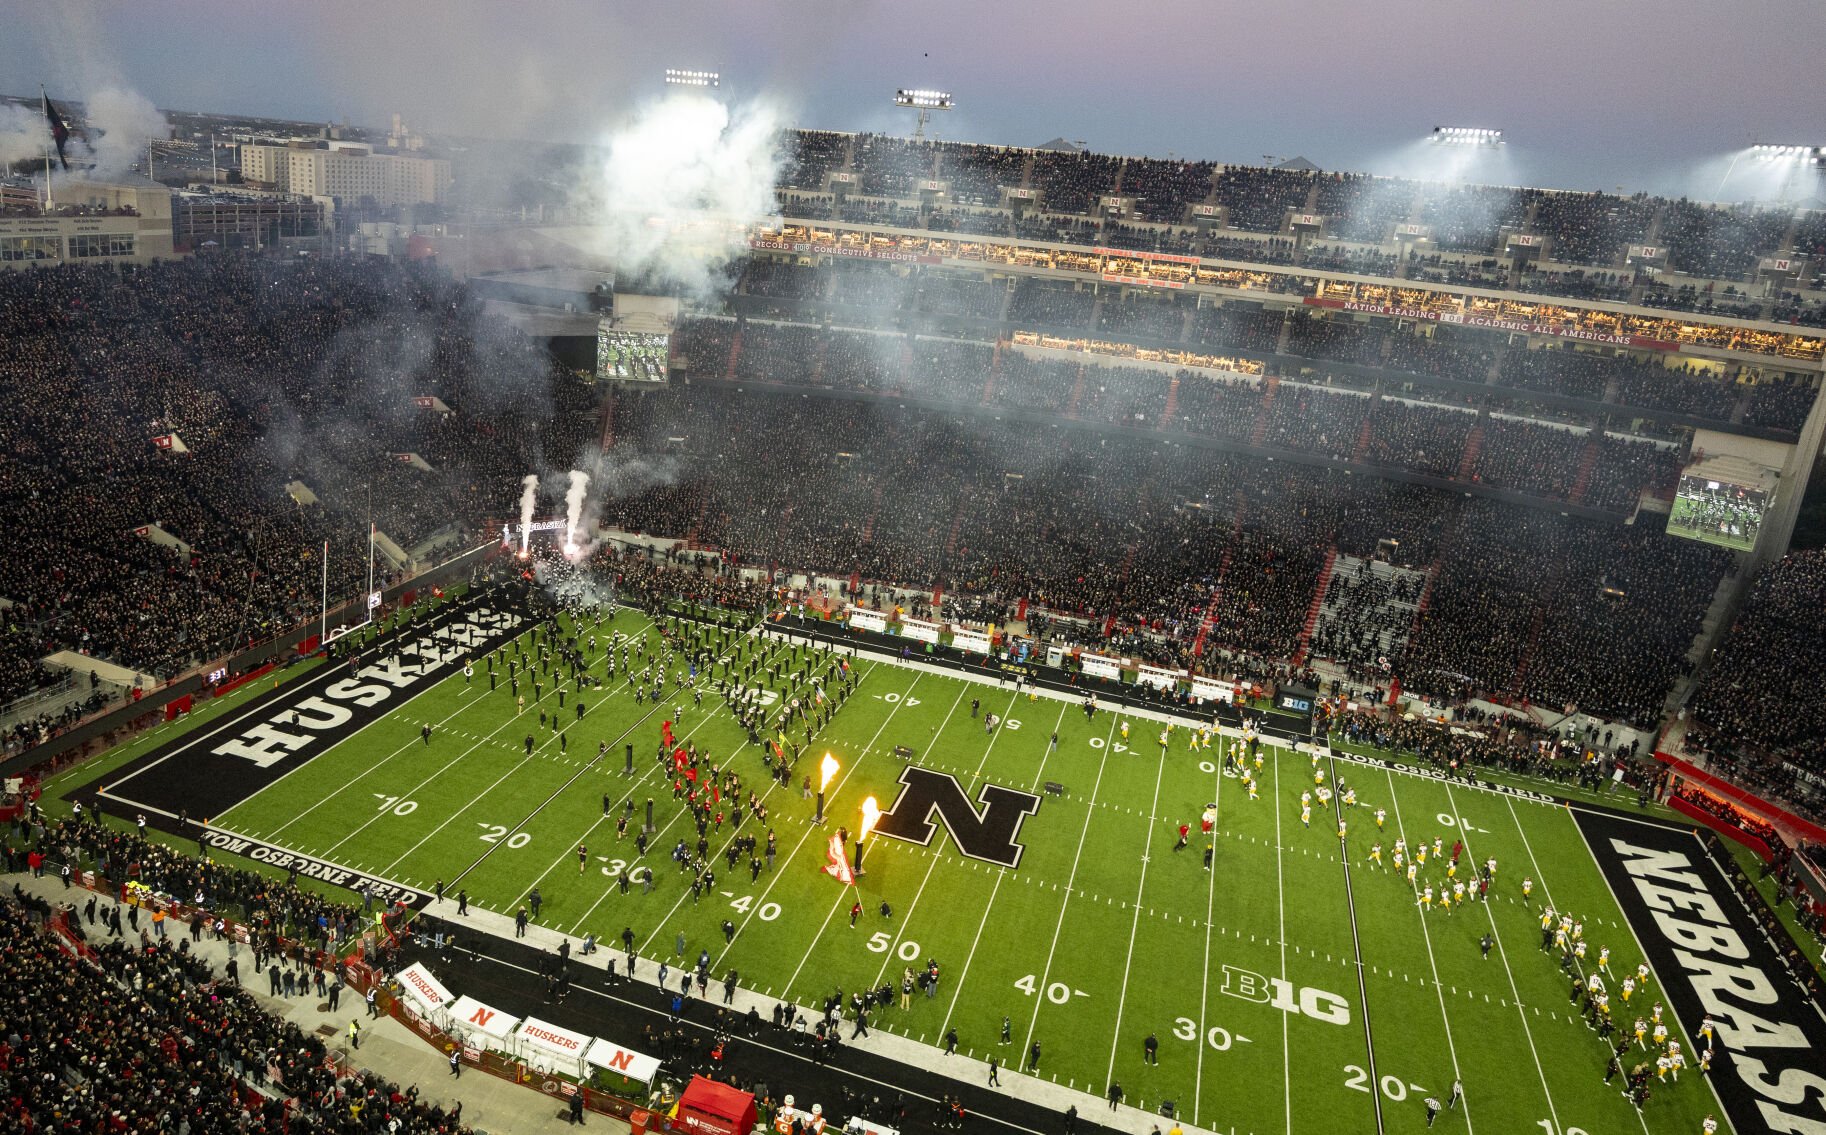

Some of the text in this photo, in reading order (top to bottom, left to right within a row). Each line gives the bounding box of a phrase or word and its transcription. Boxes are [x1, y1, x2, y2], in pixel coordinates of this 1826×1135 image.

[755, 241, 789, 249] RECORD
[814, 246, 873, 258] CONSECUTIVE
[876, 252, 917, 262] SELLOUTS
[1344, 302, 1384, 313] NATION
[1388, 308, 1435, 320] LEADING
[1468, 318, 1528, 331] ACADEMIC
[1534, 325, 1554, 334] ALL
[1560, 329, 1631, 345] AMERICANS
[211, 608, 522, 768] HUSKERS
[1341, 752, 1387, 768] TOM
[1495, 784, 1555, 803] FIELD
[873, 764, 1043, 870] N
[202, 830, 418, 905] TOM OSBORNE FIELD
[405, 969, 441, 1004] HUSKERS
[468, 1007, 495, 1027] N
[523, 1025, 580, 1050] HUSKERS
[609, 1050, 635, 1071] N
[779, 1123, 789, 1133] G
